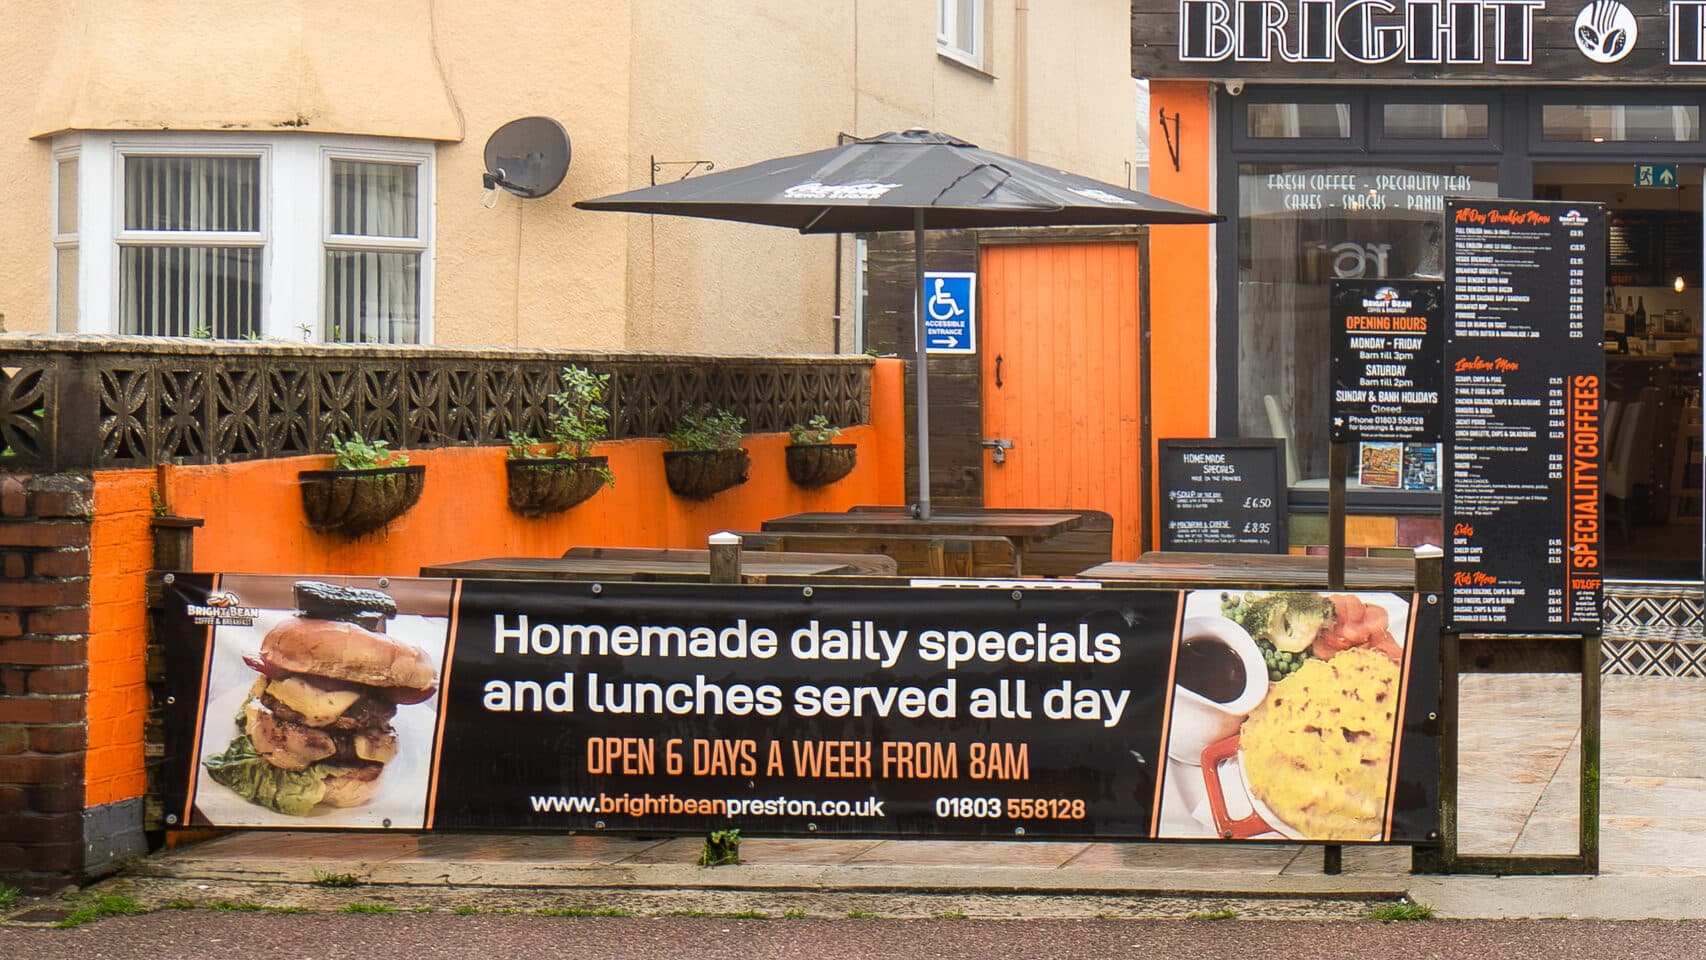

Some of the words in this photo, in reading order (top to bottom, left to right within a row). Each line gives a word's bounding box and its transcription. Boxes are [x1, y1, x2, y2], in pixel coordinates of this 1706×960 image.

[1267, 175, 1305, 190] FRESH
[1310, 175, 1356, 190] COFFEE
[1376, 175, 1440, 191] SPECIALITY
[1443, 176, 1471, 191] TEAS
[1284, 194, 1322, 209] CAKES
[1342, 194, 1386, 210] SNACKS
[1407, 195, 1444, 210] PANIN
[1362, 299, 1390, 308] BRIGHT
[1391, 300, 1412, 308] BEAN
[1346, 316, 1390, 330] OPENING
[1392, 317, 1427, 331] HOURS
[1350, 337, 1386, 349] MONDAY
[1393, 338, 1423, 350] FRIDAY
[1359, 351, 1379, 359] 8am
[1379, 351, 1392, 360] till
[1393, 352, 1414, 362] 3pm
[1365, 364, 1407, 376] SATURDAY
[1359, 377, 1379, 386] 8am
[1379, 377, 1392, 386] till
[1393, 378, 1414, 388] 2pm
[1336, 390, 1367, 402] SUNDAY
[1368, 392, 1377, 402] &
[1378, 391, 1400, 403] BANK
[1402, 392, 1438, 404] HOLIDAYS
[1371, 404, 1402, 413] Closed
[1349, 416, 1374, 425] Phone
[1375, 416, 1397, 424] 01803
[1573, 375, 1599, 458] COFFEES
[1358, 424, 1388, 433] bookings
[1203, 465, 1235, 474] SPECIALS
[1573, 459, 1599, 568] SPECIALITY
[1586, 580, 1601, 589] OFF
[187, 604, 225, 617] BRIGHT
[229, 606, 258, 618] BEAN
[494, 614, 778, 659] Homemade
[790, 620, 908, 669] daily
[918, 622, 1122, 670] specials
[483, 673, 574, 713] and
[587, 673, 783, 718] lunches
[793, 678, 957, 719] served
[969, 680, 1032, 720] all
[1043, 680, 1131, 728] day
[587, 738, 656, 776] OPEN
[666, 741, 683, 775] 6
[693, 739, 757, 777] DAYS
[766, 740, 785, 777] A
[792, 741, 872, 779] WEEK
[882, 742, 958, 780] FROM
[969, 743, 1029, 781] 8AM
[530, 792, 885, 821] www.brightbeanpreston.co.uk
[936, 797, 1002, 819] 01803
[1007, 798, 1086, 820] 558128
